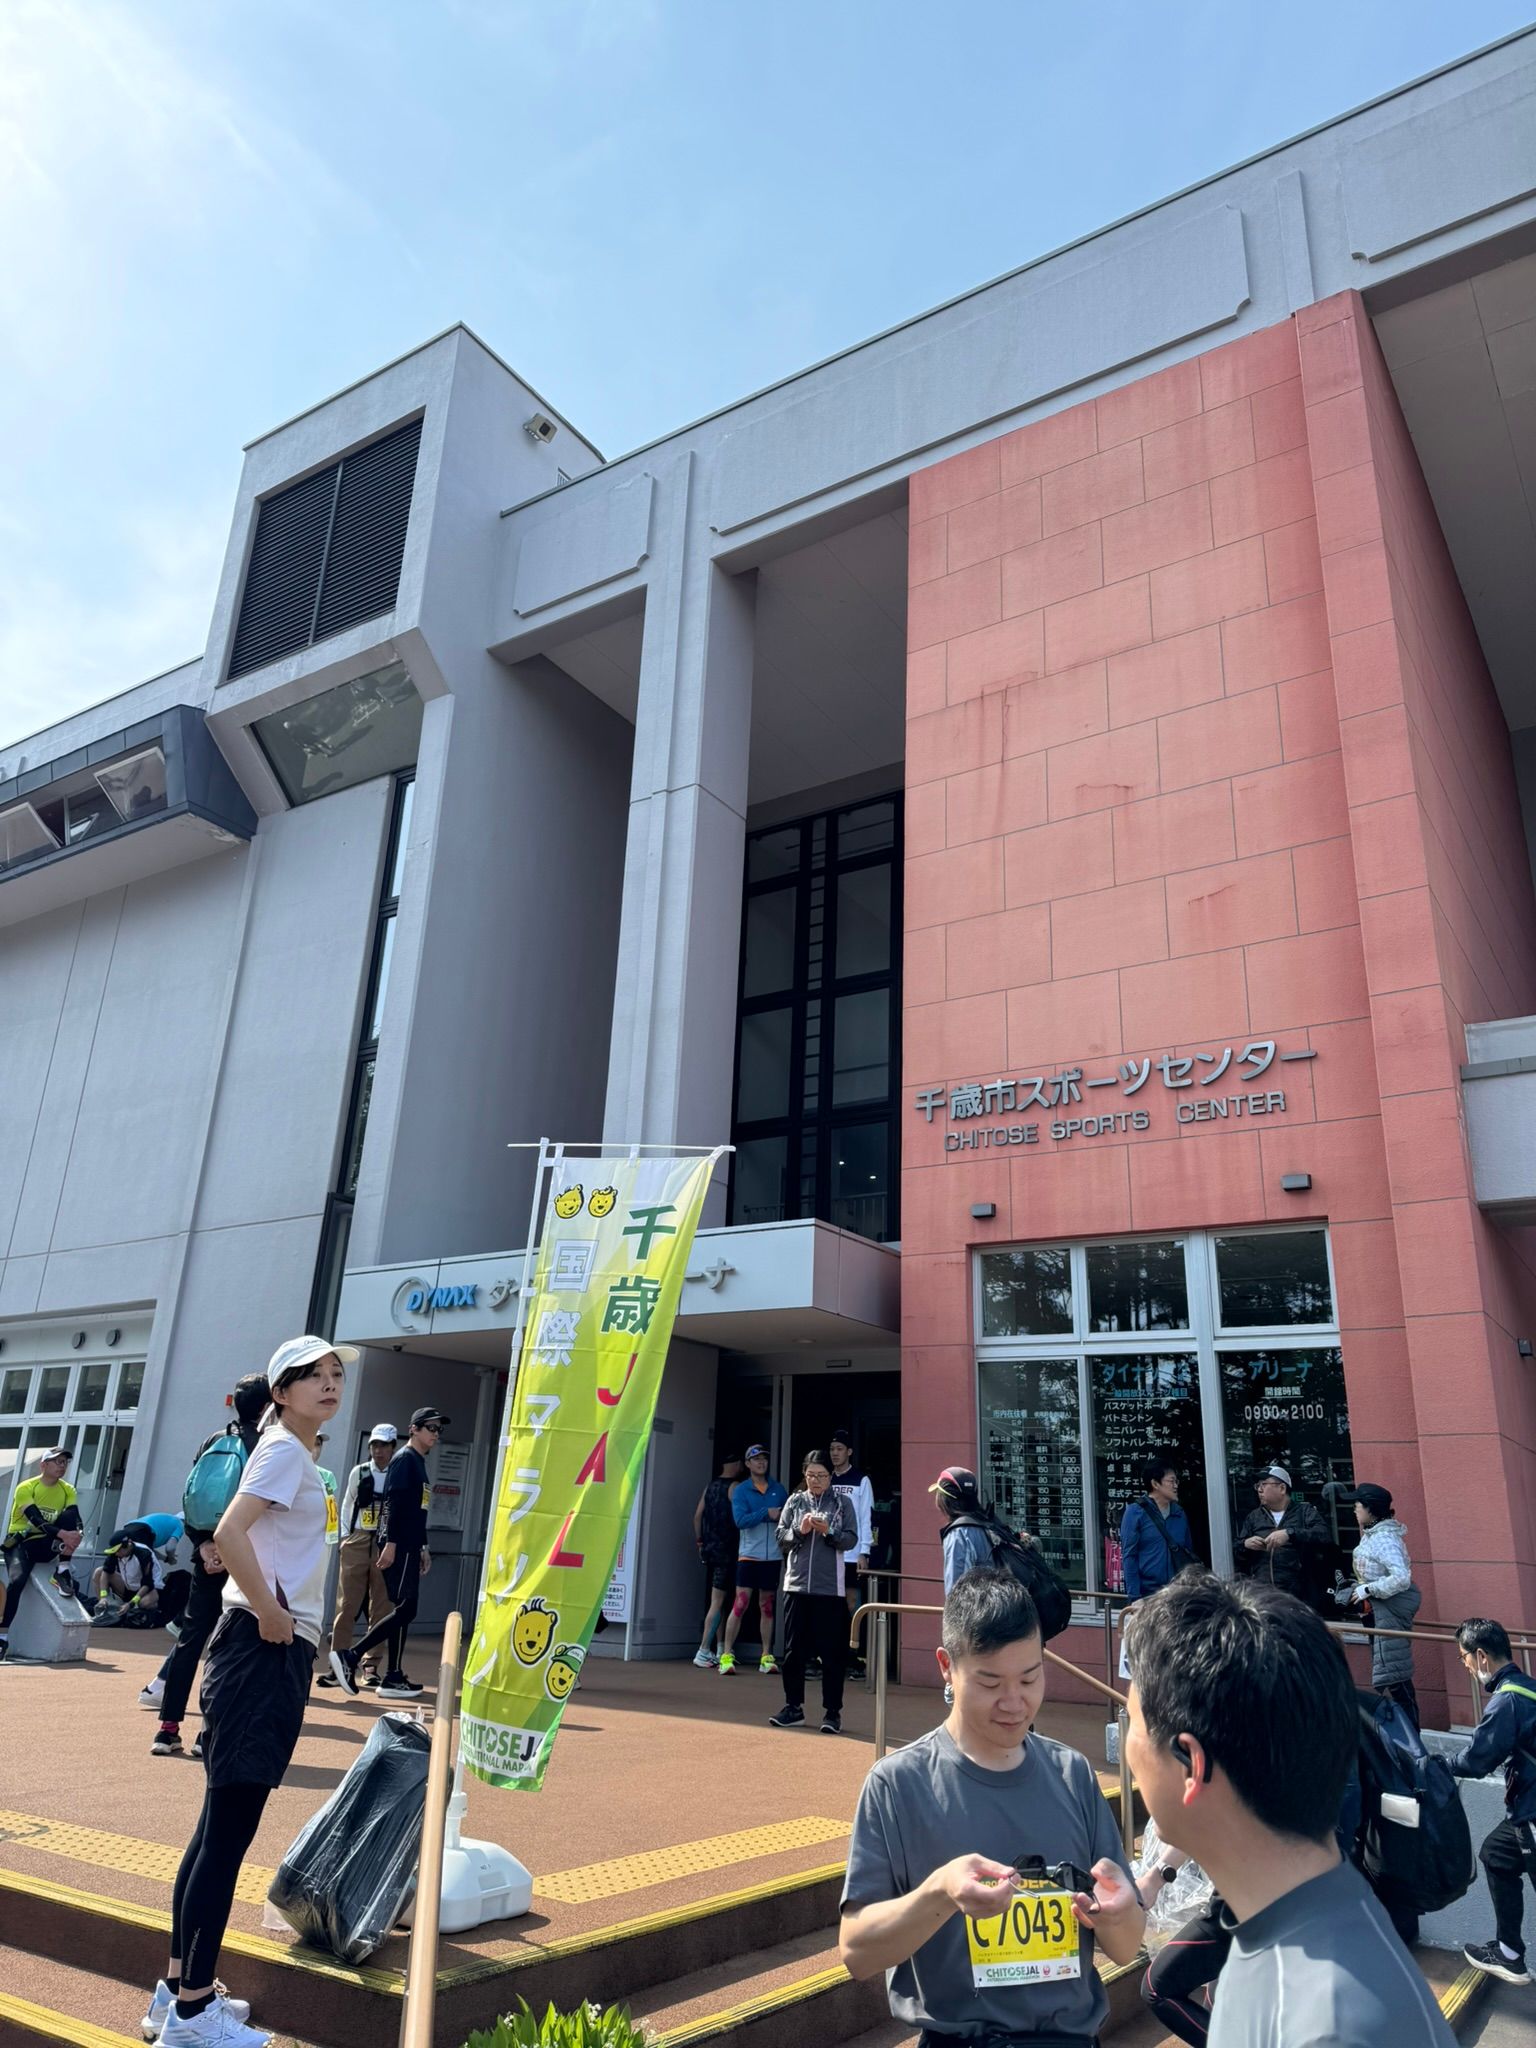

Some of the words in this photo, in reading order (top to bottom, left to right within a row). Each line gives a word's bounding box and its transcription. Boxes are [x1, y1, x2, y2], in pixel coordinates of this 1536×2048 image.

[914, 1040, 1317, 1122] 千歳市スポーツセンター
[944, 1124, 1039, 1152] CHITOSE
[1050, 1110, 1150, 1140] SPORTS
[1176, 1090, 1287, 1124] CENTER
[406, 1284, 478, 1314] DYNAX
[1248, 1358, 1313, 1381] アリーナ
[1103, 1401, 1169, 1411] バスケットボール
[1104, 1426, 1171, 1435] ミニバレーボール
[1105, 1438, 1180, 1448] ソフトバレーボール
[1062, 1456, 1077, 1464] 800
[1106, 1451, 1156, 1461] バレーボール
[833, 1486, 854, 1494] DER
[986, 1965, 1040, 1977] CHITOSEJAL
